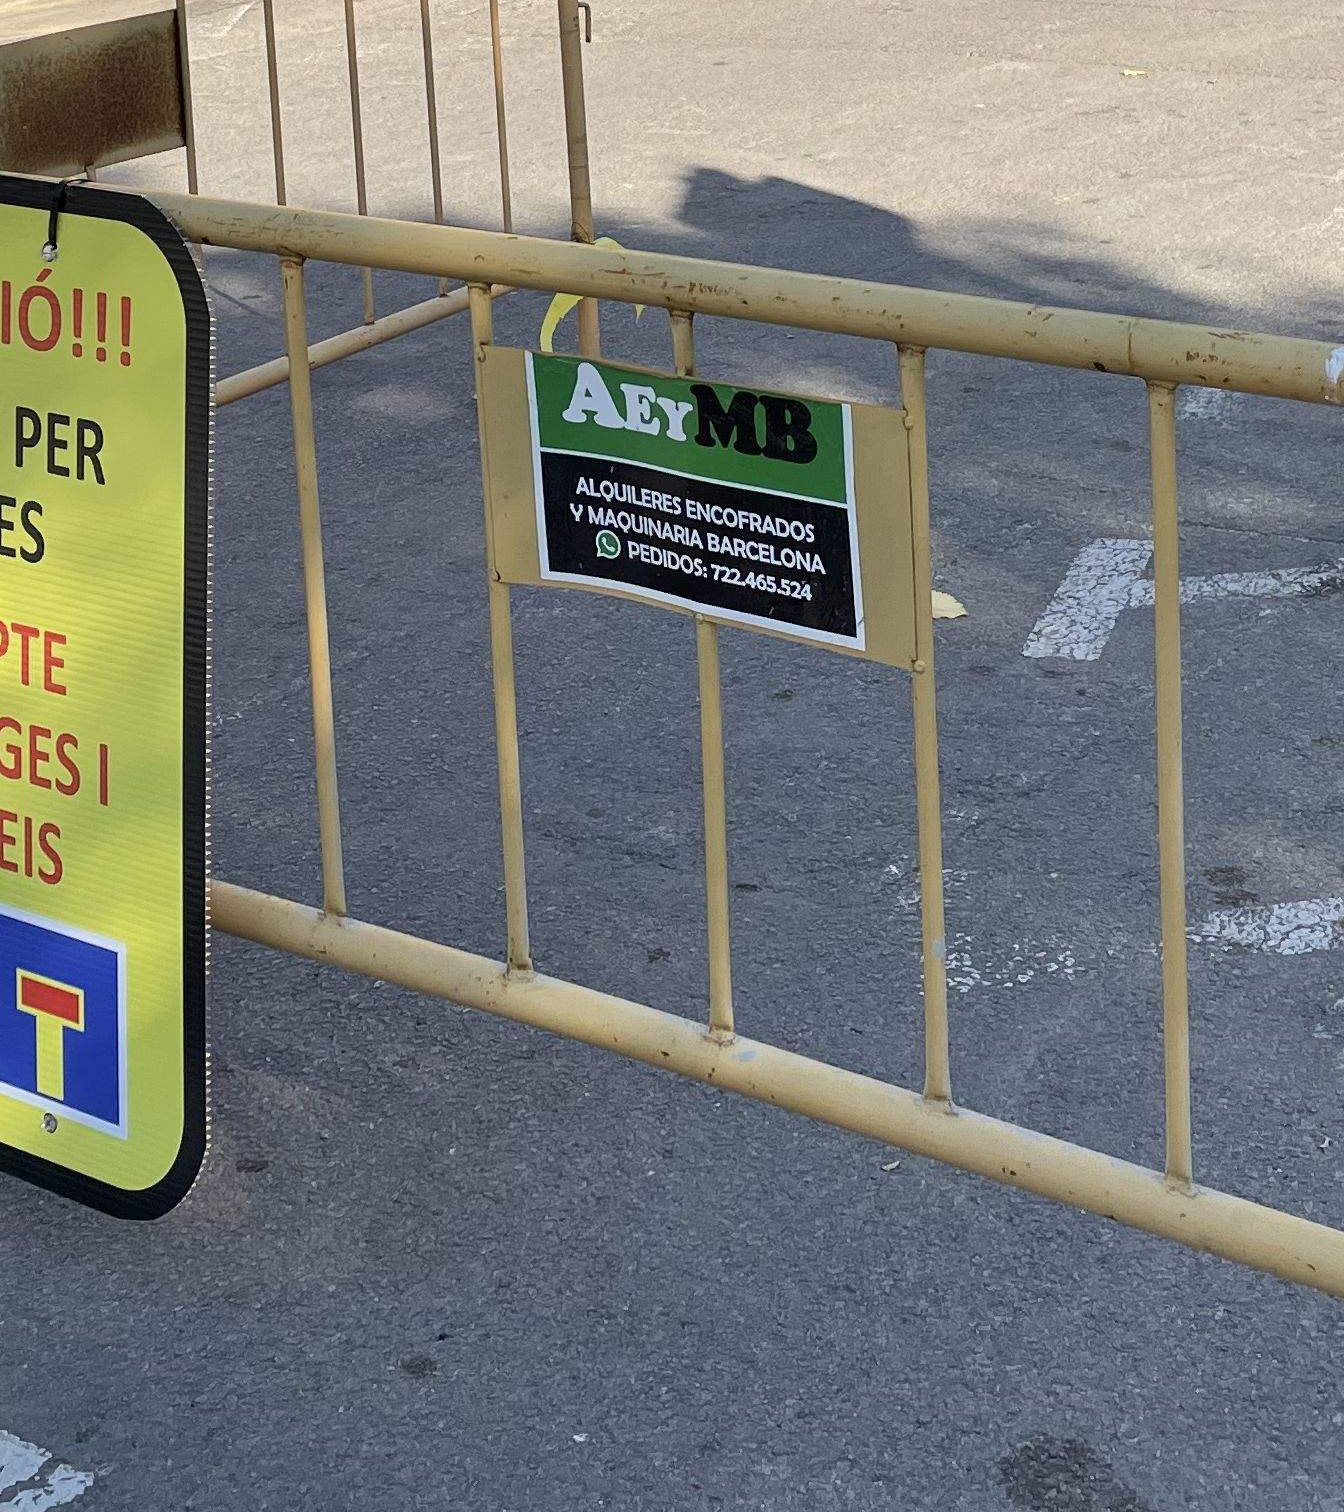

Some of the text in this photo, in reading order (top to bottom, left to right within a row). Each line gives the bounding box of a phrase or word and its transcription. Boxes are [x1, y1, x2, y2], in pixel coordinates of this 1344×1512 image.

[15, 405, 106, 485] PER
[569, 502, 827, 575] Y MAQUINARIA BARCELONA
[576, 476, 815, 543] ALQUILERES ENCOFRADOS
[627, 541, 813, 601] PEDIDOS: 722.465.524
[99, 743, 109, 807] I
